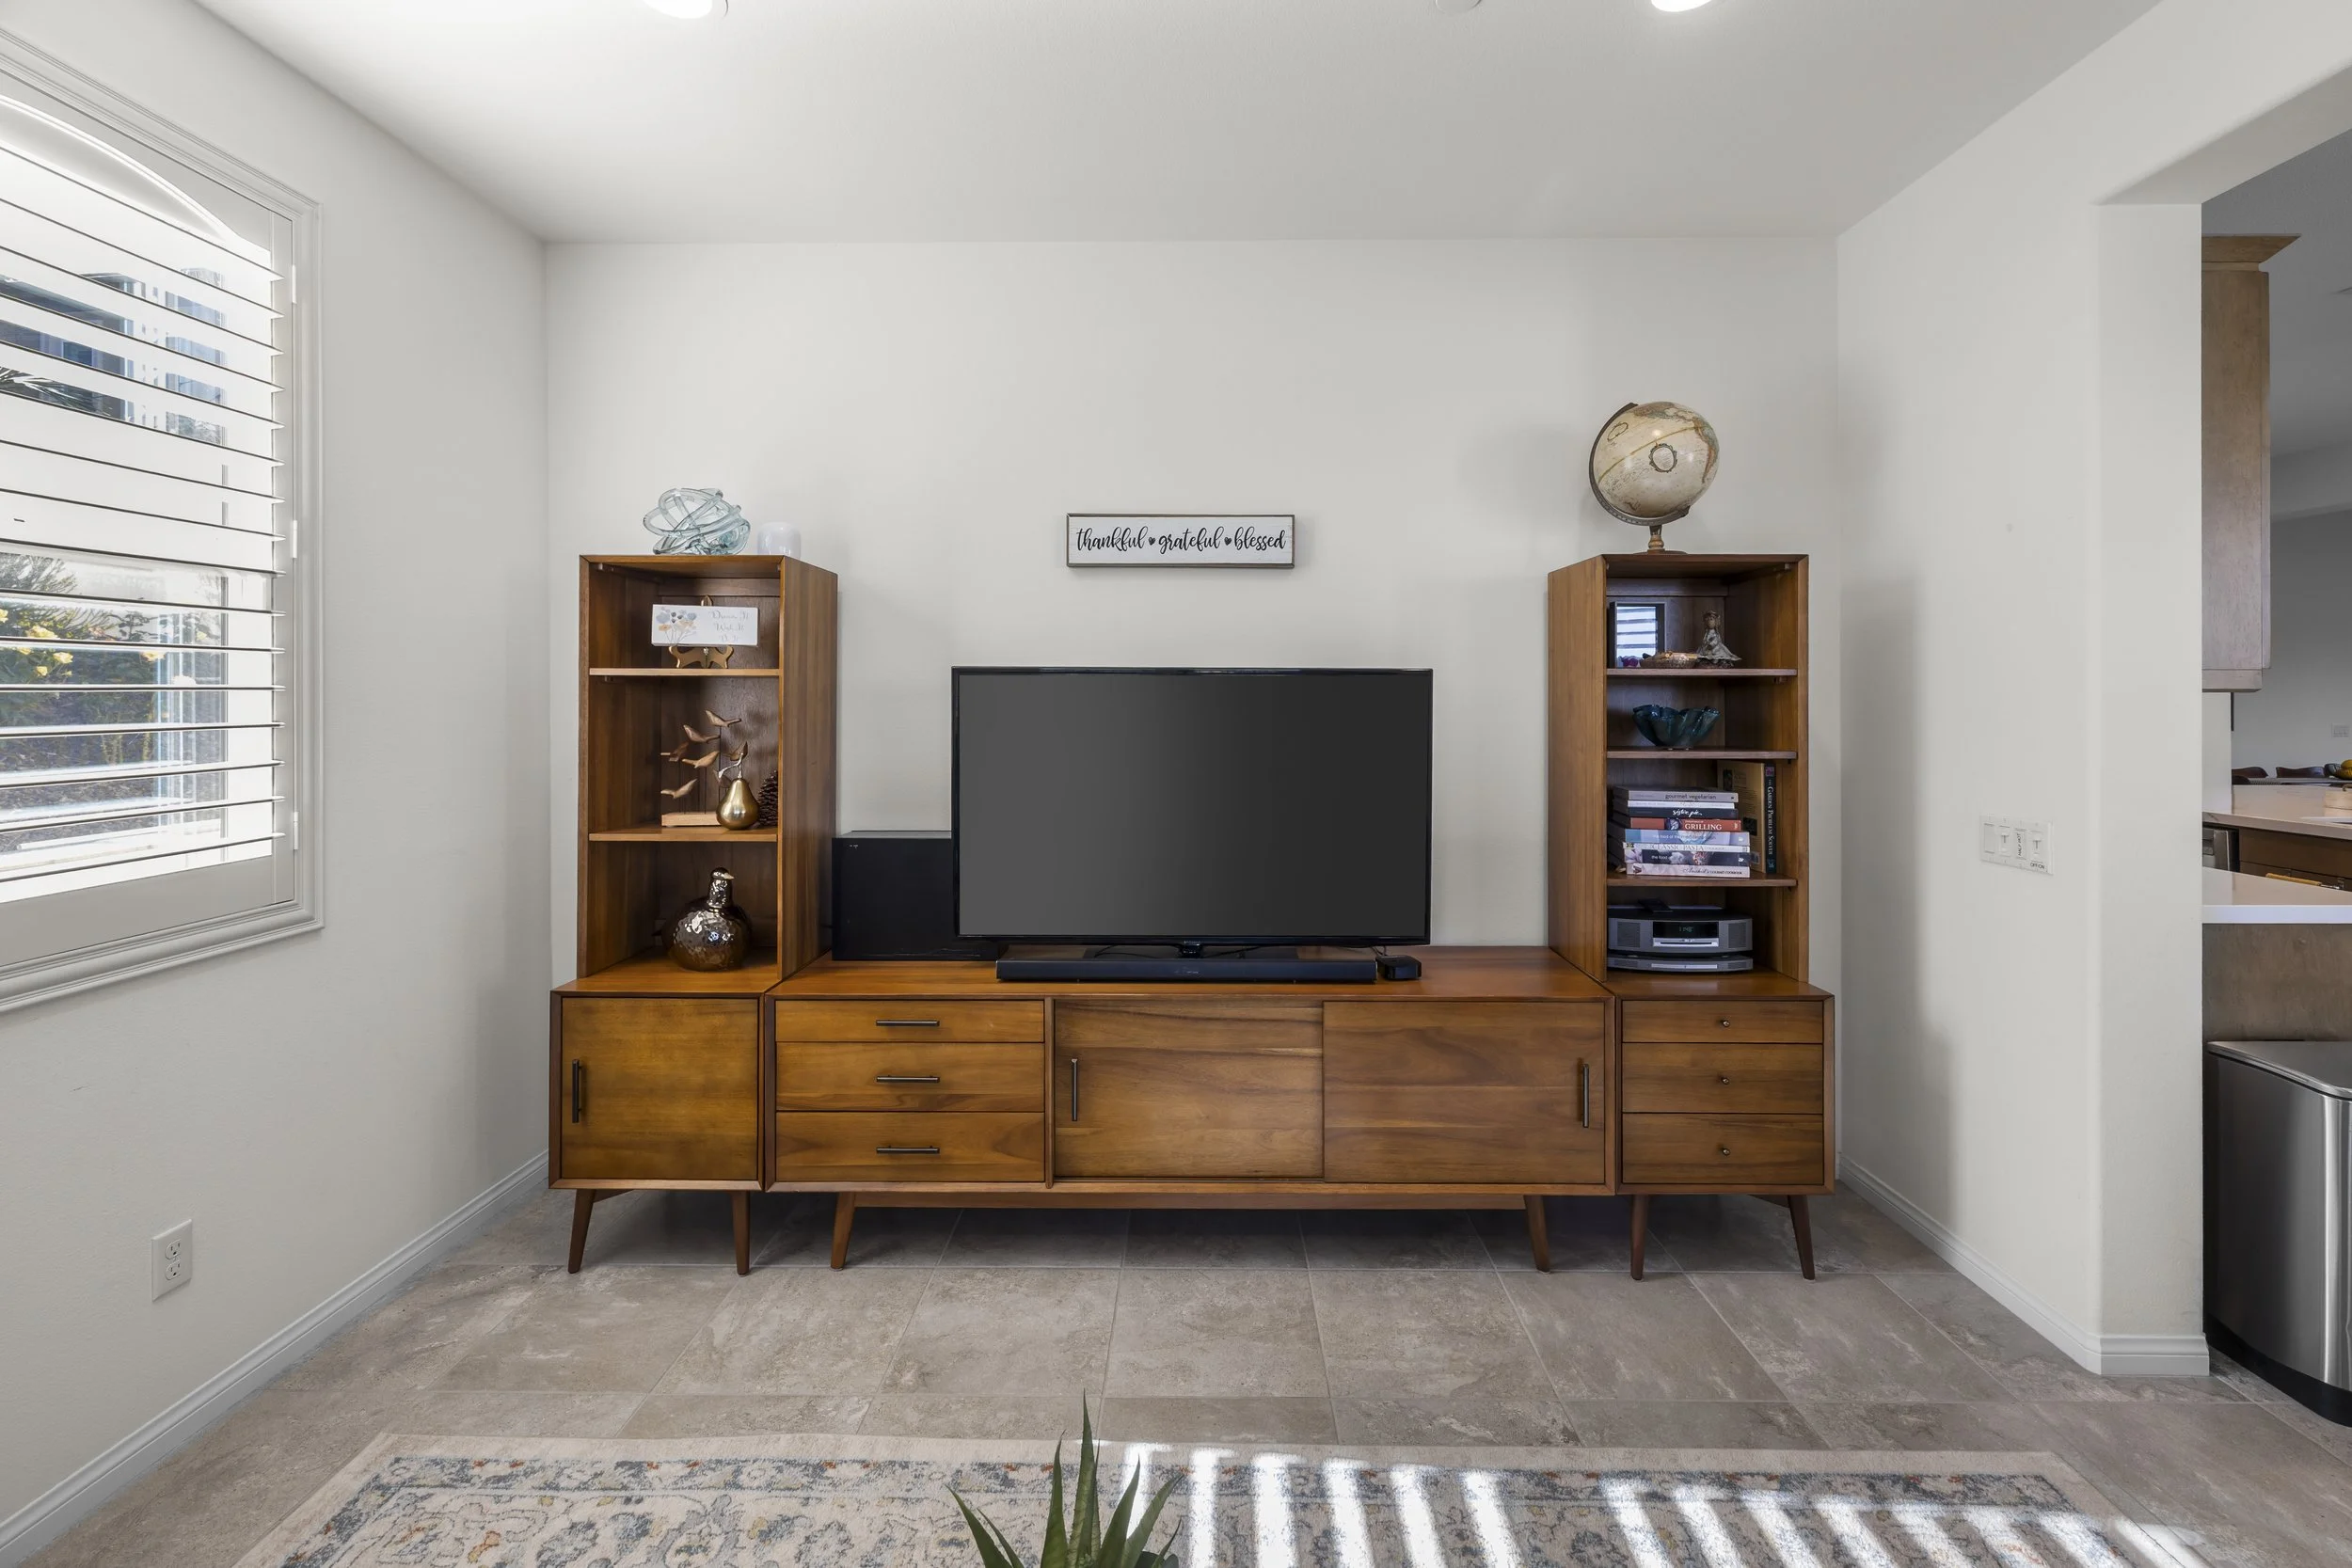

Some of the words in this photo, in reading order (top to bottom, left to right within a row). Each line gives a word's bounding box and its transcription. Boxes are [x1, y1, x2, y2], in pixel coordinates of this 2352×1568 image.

[1075, 526, 1149, 552] thankful
[1158, 526, 1225, 554] grateful
[1233, 526, 1287, 551] blessed
